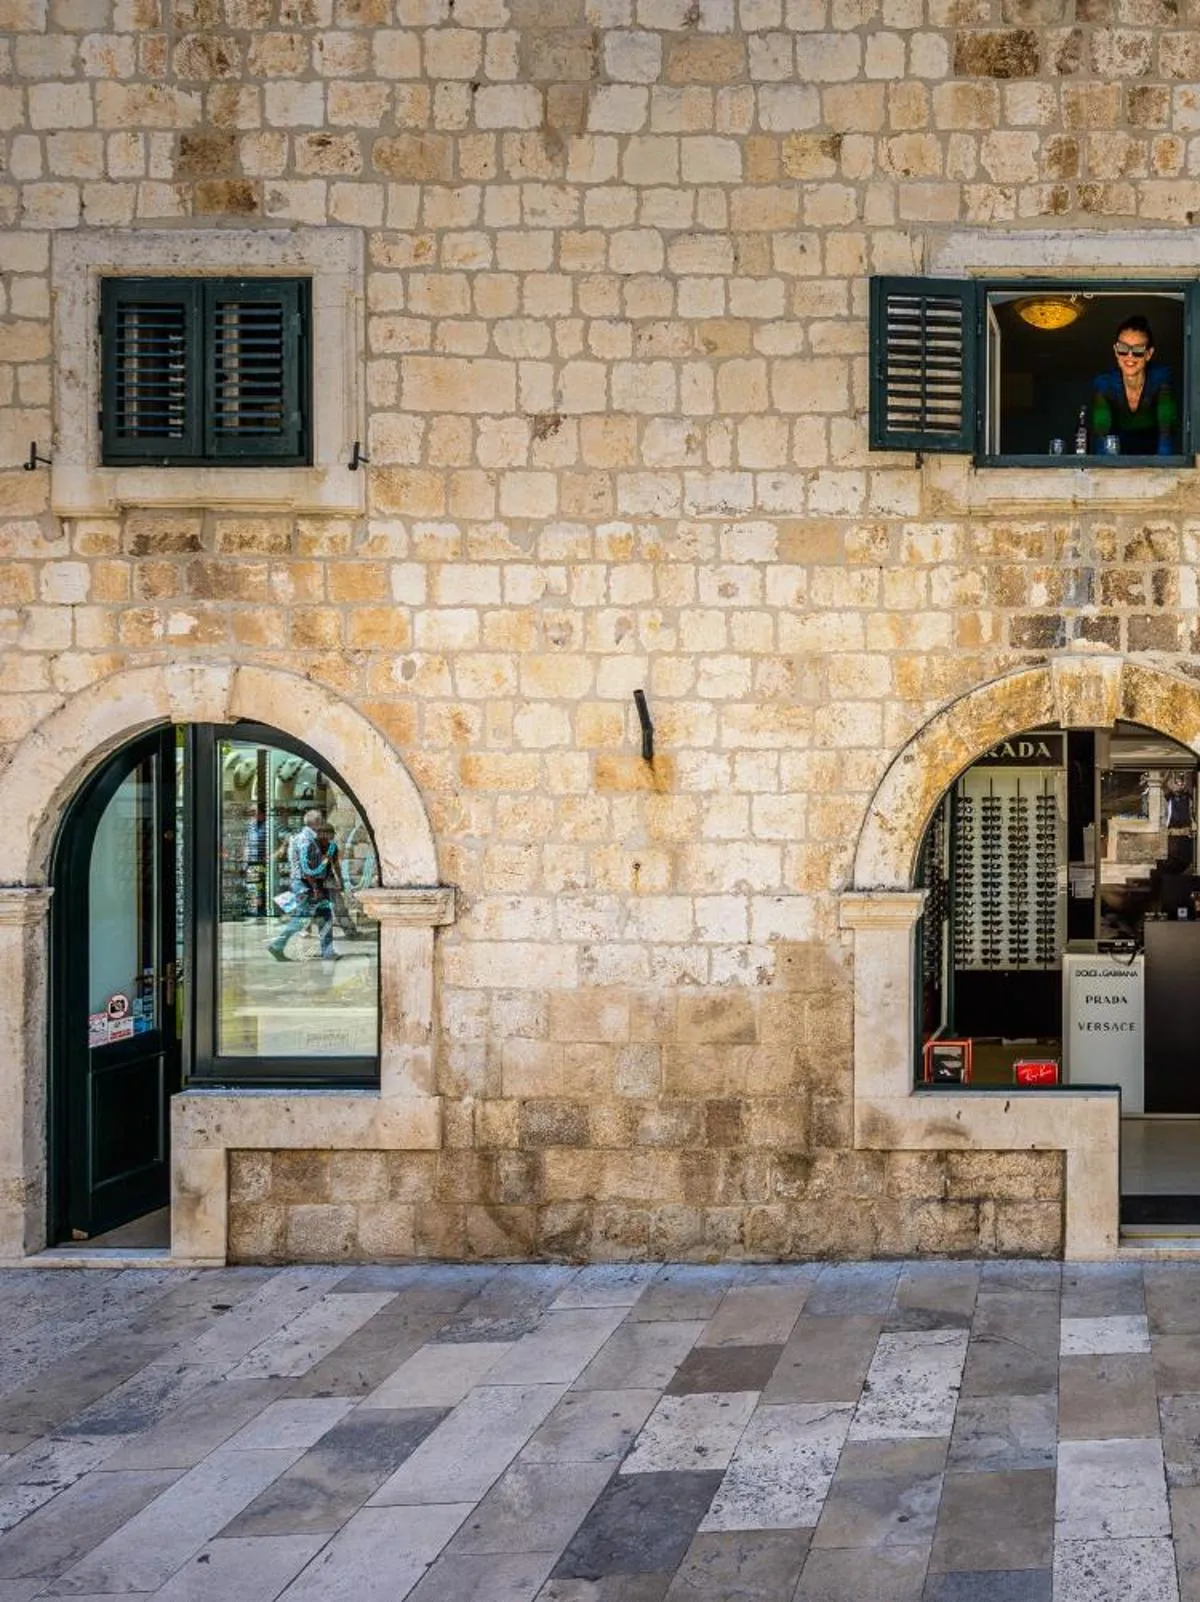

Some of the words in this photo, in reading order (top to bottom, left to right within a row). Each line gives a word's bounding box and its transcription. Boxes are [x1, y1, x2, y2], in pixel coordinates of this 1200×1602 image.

[984, 741, 1052, 758] ADA
[1085, 994, 1128, 1005] PRADA
[1077, 1021, 1137, 1033] VERSACE
